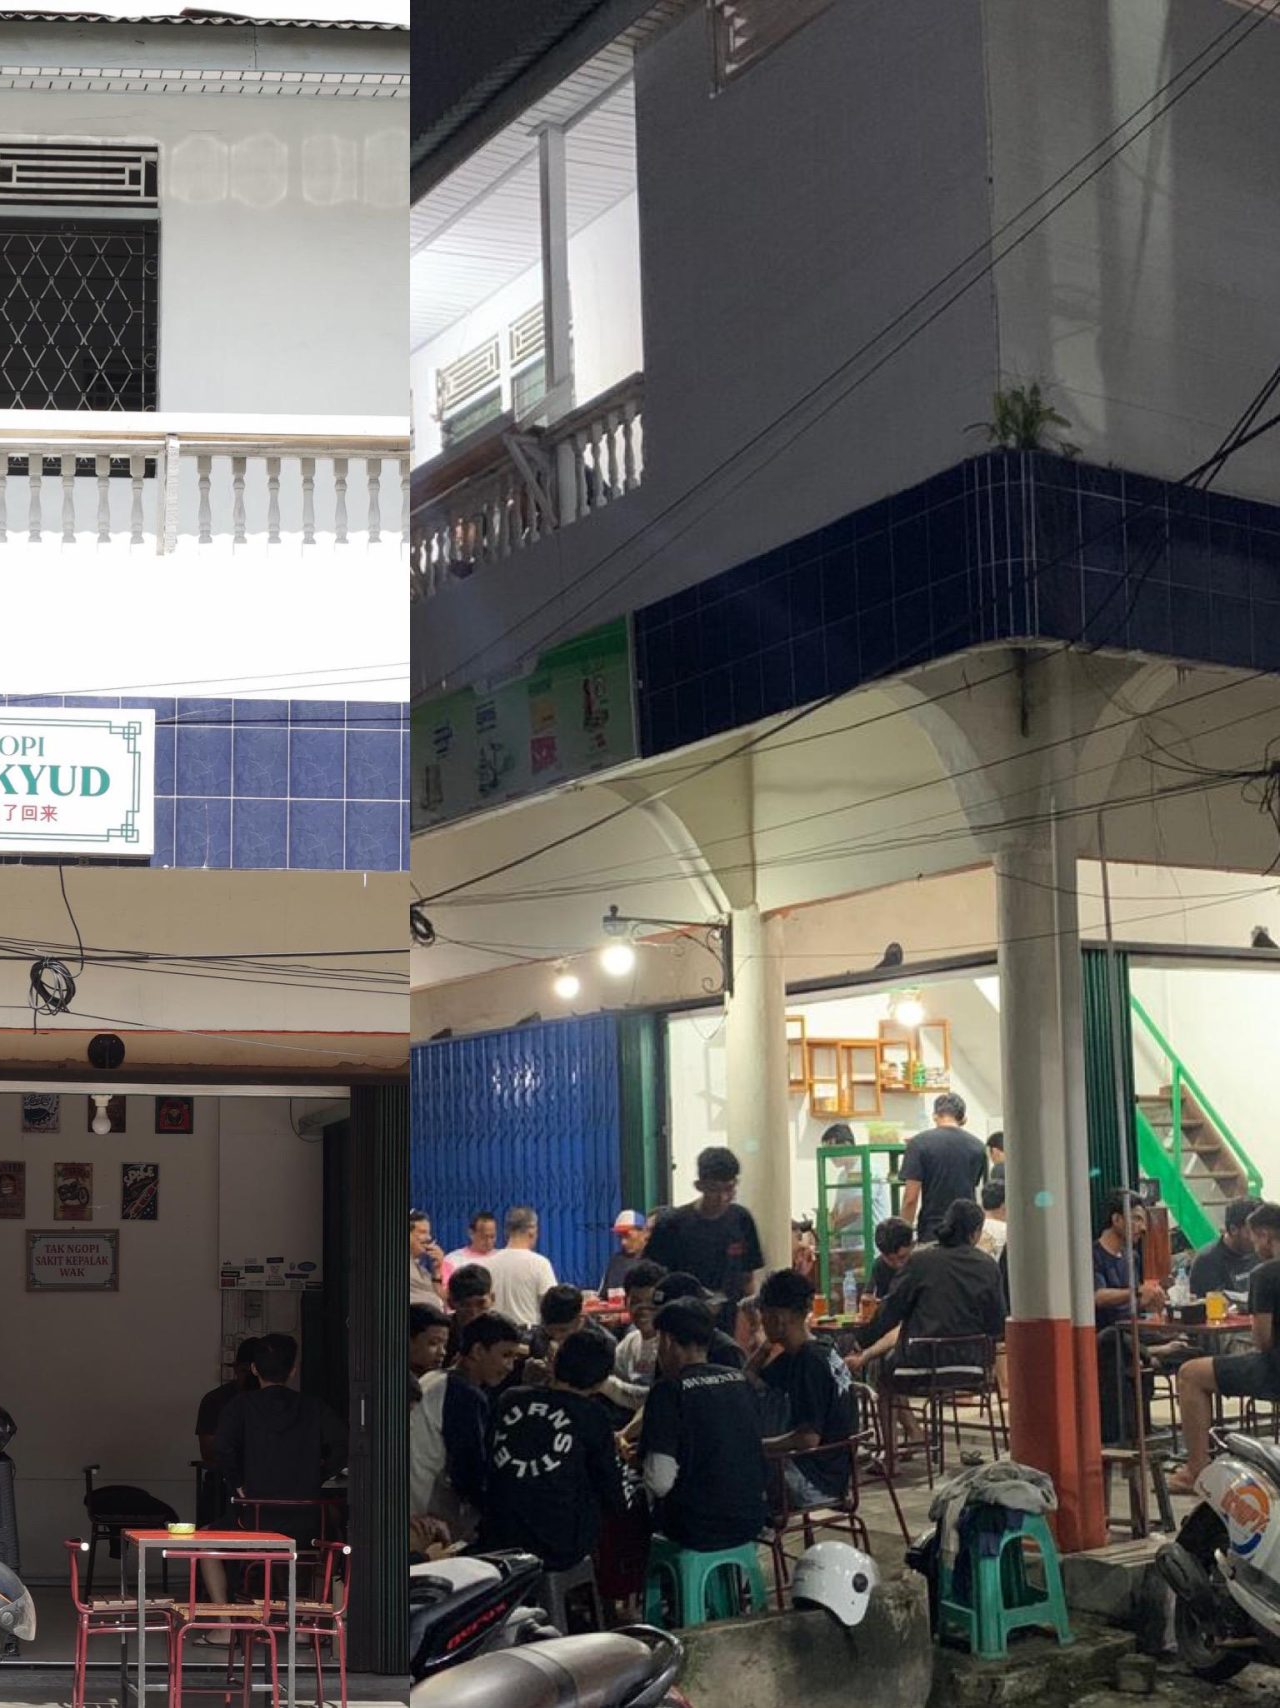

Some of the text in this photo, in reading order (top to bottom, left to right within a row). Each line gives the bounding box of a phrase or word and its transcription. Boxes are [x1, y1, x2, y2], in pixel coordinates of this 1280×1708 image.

[44, 1244, 100, 1254] TAK NGOPI
[35, 1256, 109, 1266] SAKIT KEPALAK
[59, 1267, 85, 1277] WAK
